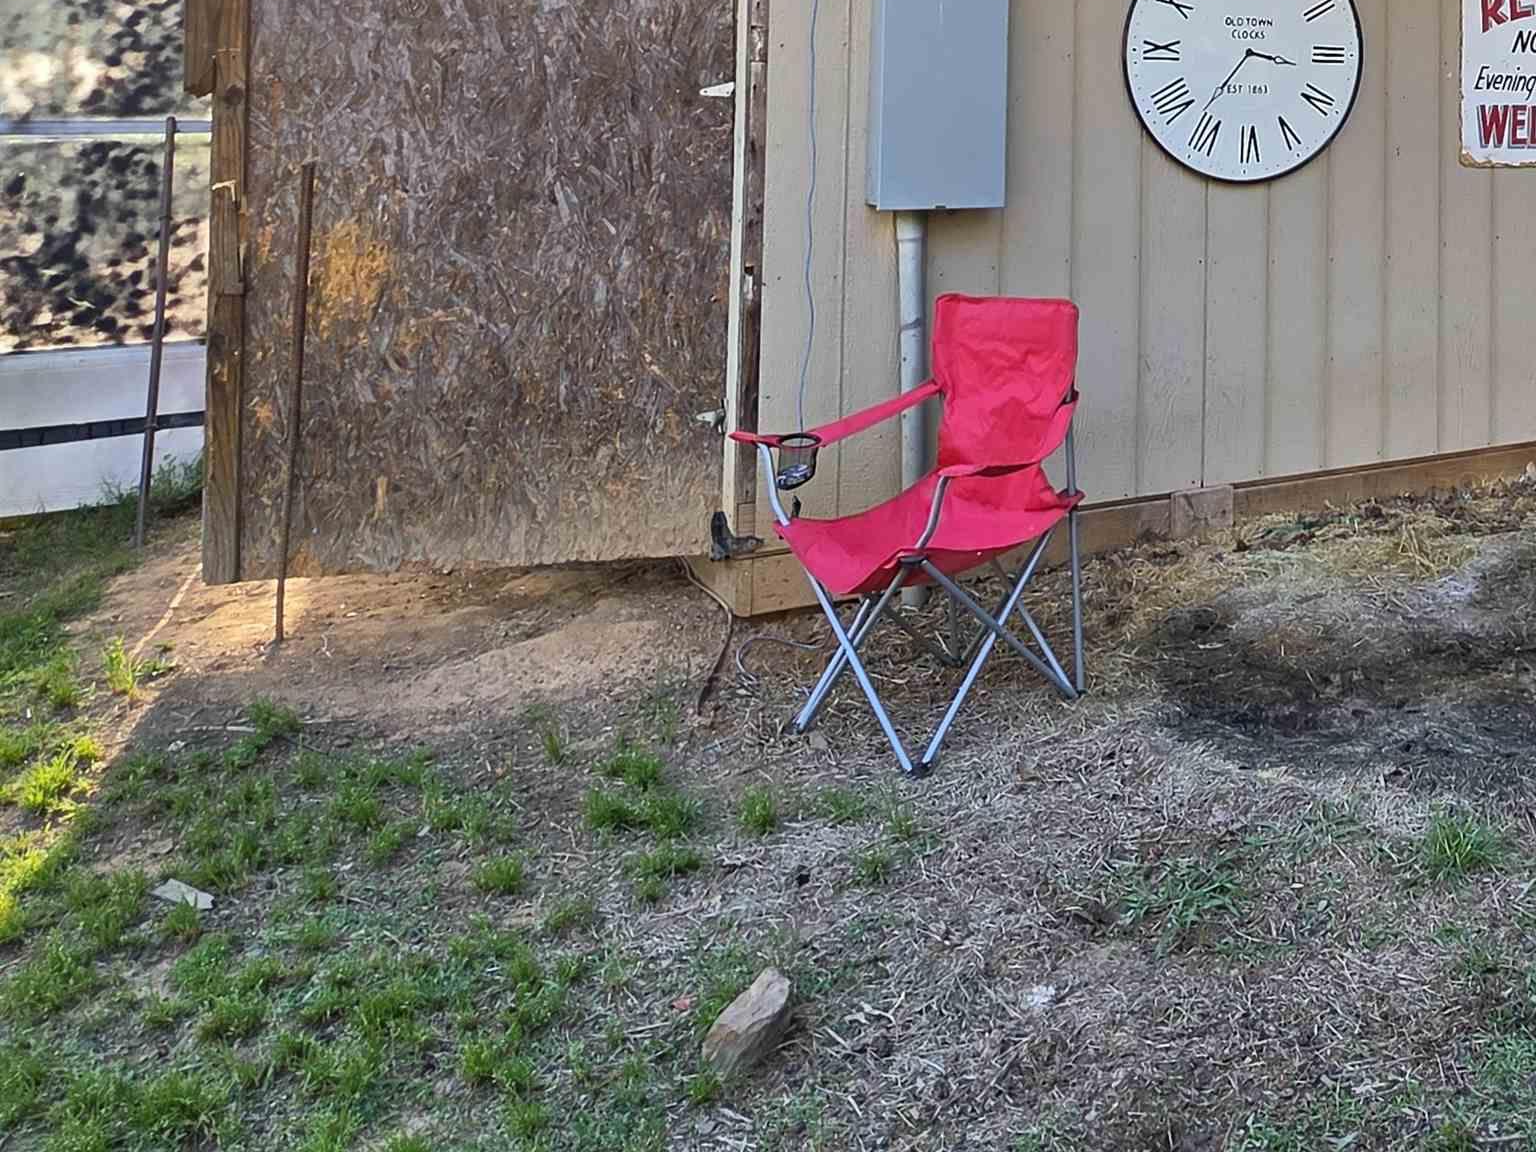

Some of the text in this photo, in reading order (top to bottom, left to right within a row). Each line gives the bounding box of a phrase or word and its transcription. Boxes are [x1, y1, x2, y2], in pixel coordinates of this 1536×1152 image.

[1225, 16, 1273, 27] OLD TOWN
[1231, 29, 1265, 40] CLOCKS
[1474, 66, 1536, 100] Evening
[1227, 84, 1243, 94] EST
